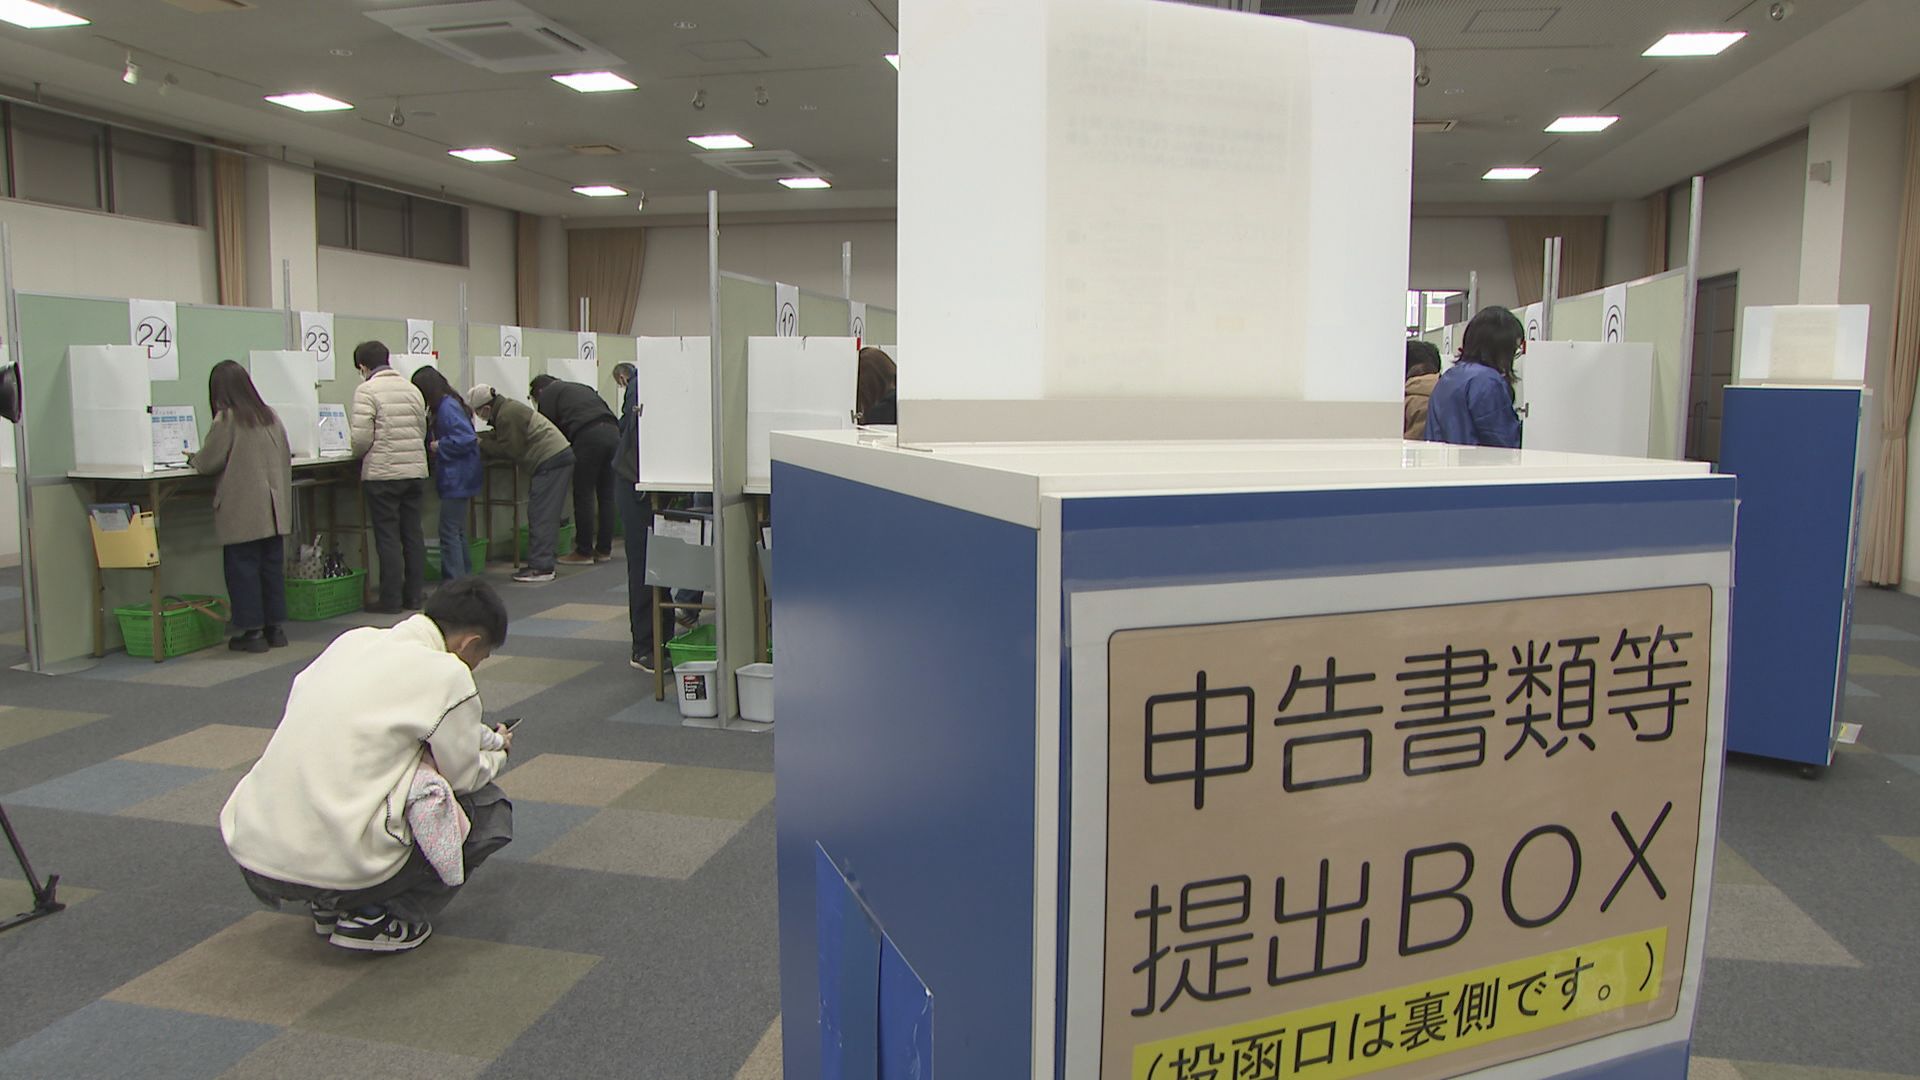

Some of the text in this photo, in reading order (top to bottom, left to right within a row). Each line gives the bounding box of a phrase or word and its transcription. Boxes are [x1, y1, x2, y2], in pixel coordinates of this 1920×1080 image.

[138, 323, 171, 348] 24
[306, 332, 330, 352] 23
[412, 336, 430, 355] 22
[504, 340, 517, 357] 21
[1144, 625, 1694, 811] 申告書類等
[1130, 801, 1673, 1017] 提出BOX
